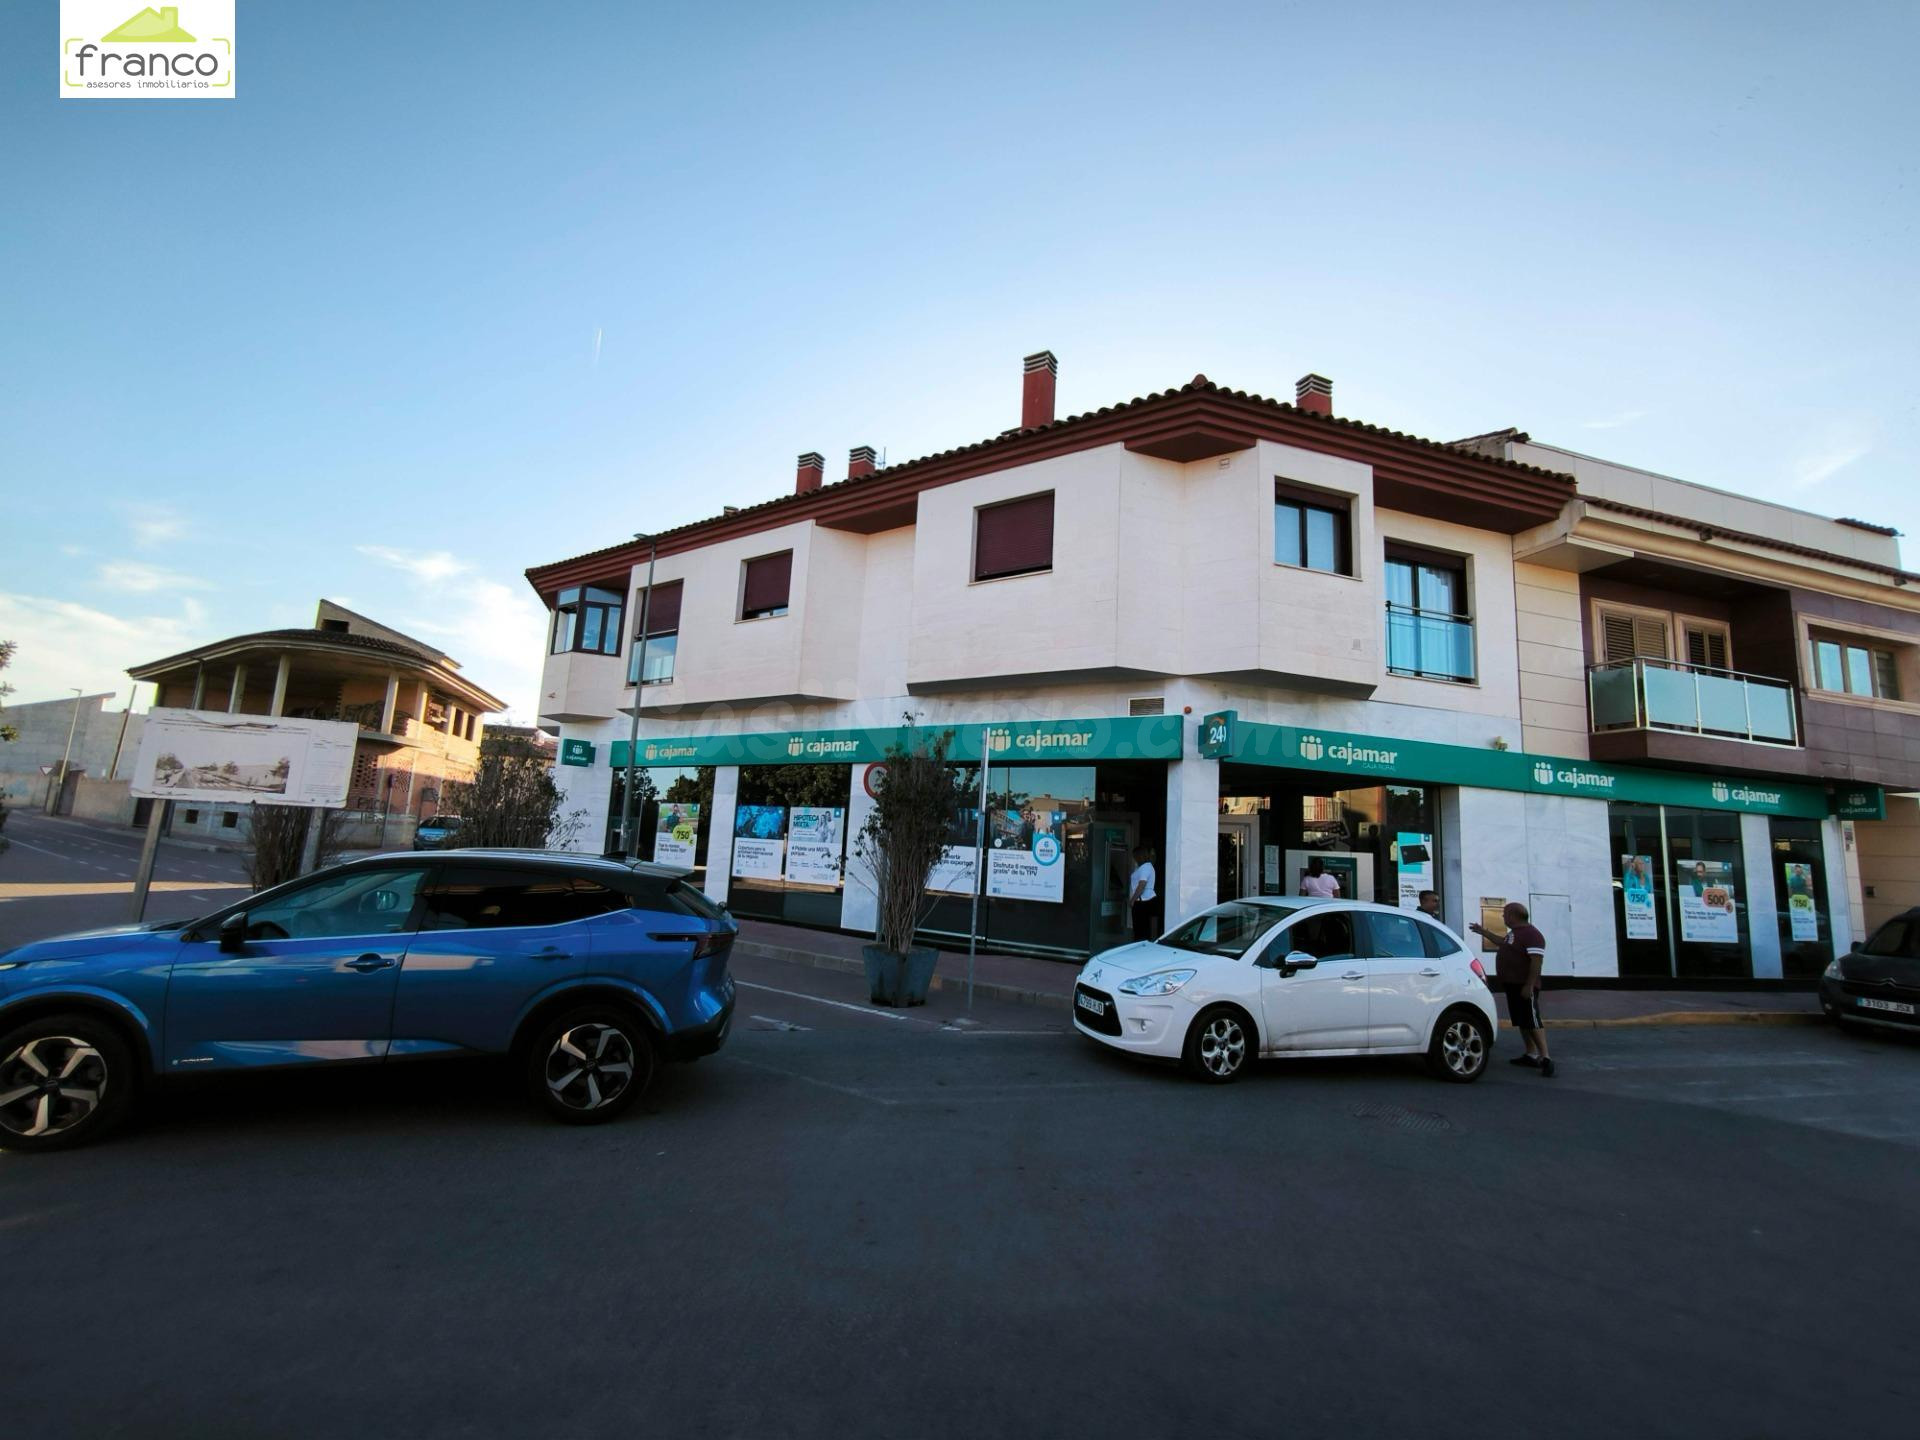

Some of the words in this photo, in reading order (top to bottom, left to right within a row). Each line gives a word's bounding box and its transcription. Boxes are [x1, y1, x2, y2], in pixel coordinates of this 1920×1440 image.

[806, 737, 860, 758] cajamar
[1016, 729, 1092, 752] cajamar
[659, 744, 698, 760] cajamar
[1328, 742, 1397, 766] cajamar
[1557, 767, 1615, 789] cajamar
[1731, 786, 1781, 805] cajamar
[1839, 806, 1877, 816] cajamar
[676, 830, 690, 839] 750
[993, 862, 1015, 870] Disfruta
[1026, 869, 1038, 877] TPV
[1630, 893, 1646, 903] 750
[1707, 894, 1725, 906] 500
